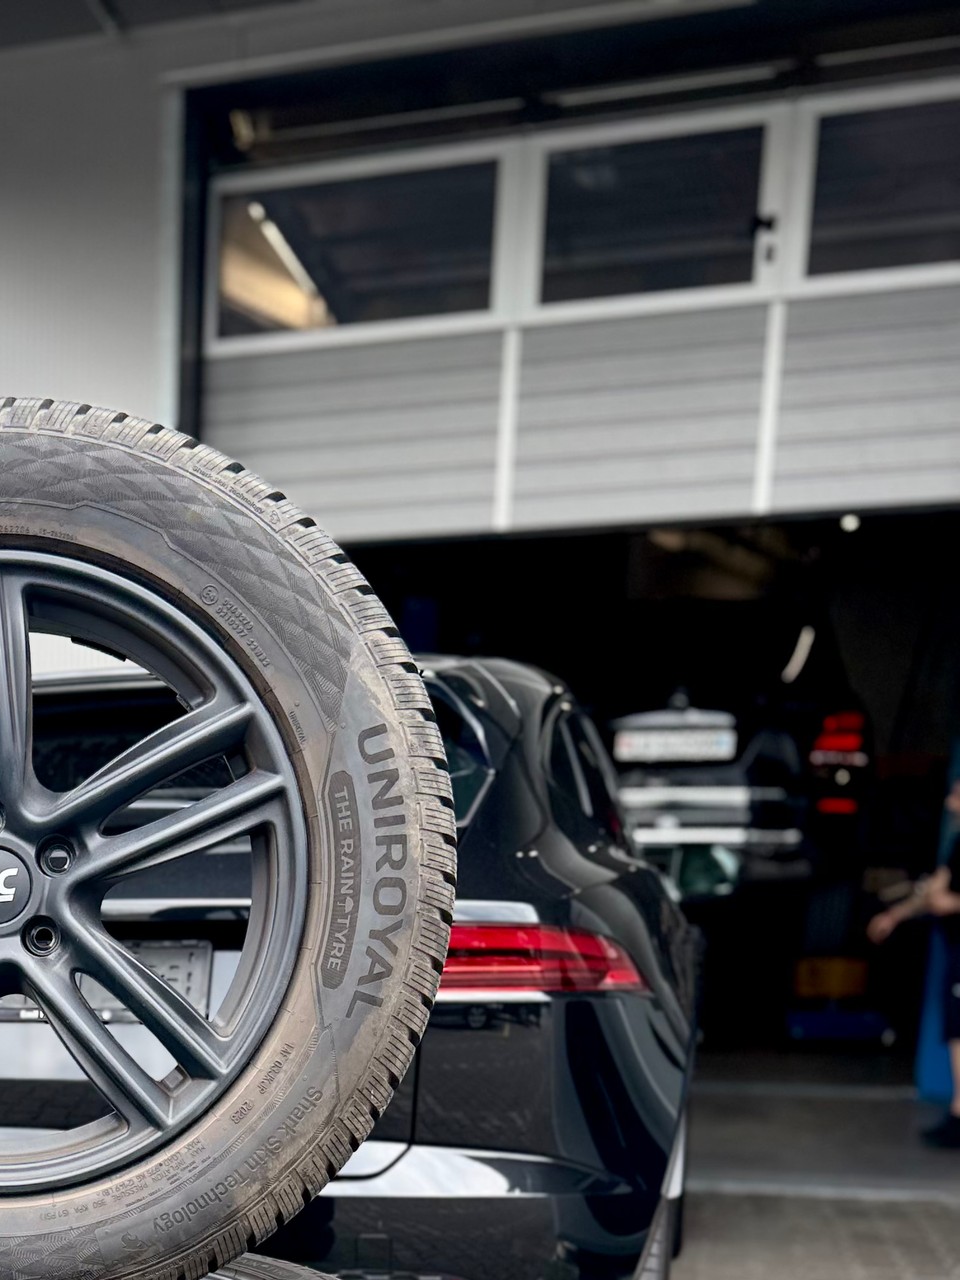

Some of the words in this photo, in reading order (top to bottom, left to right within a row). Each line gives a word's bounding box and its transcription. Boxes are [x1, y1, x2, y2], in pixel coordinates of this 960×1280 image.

[334, 786, 352, 831] THE
[339, 838, 354, 895] RAIN
[345, 722, 407, 1019] UNIROYAL
[327, 915, 352, 971] TYRE
[231, 1100, 255, 1124] 2023
[277, 1085, 323, 1140] Shark
[244, 1135, 281, 1174] Skin
[153, 1168, 249, 1235] Technology
